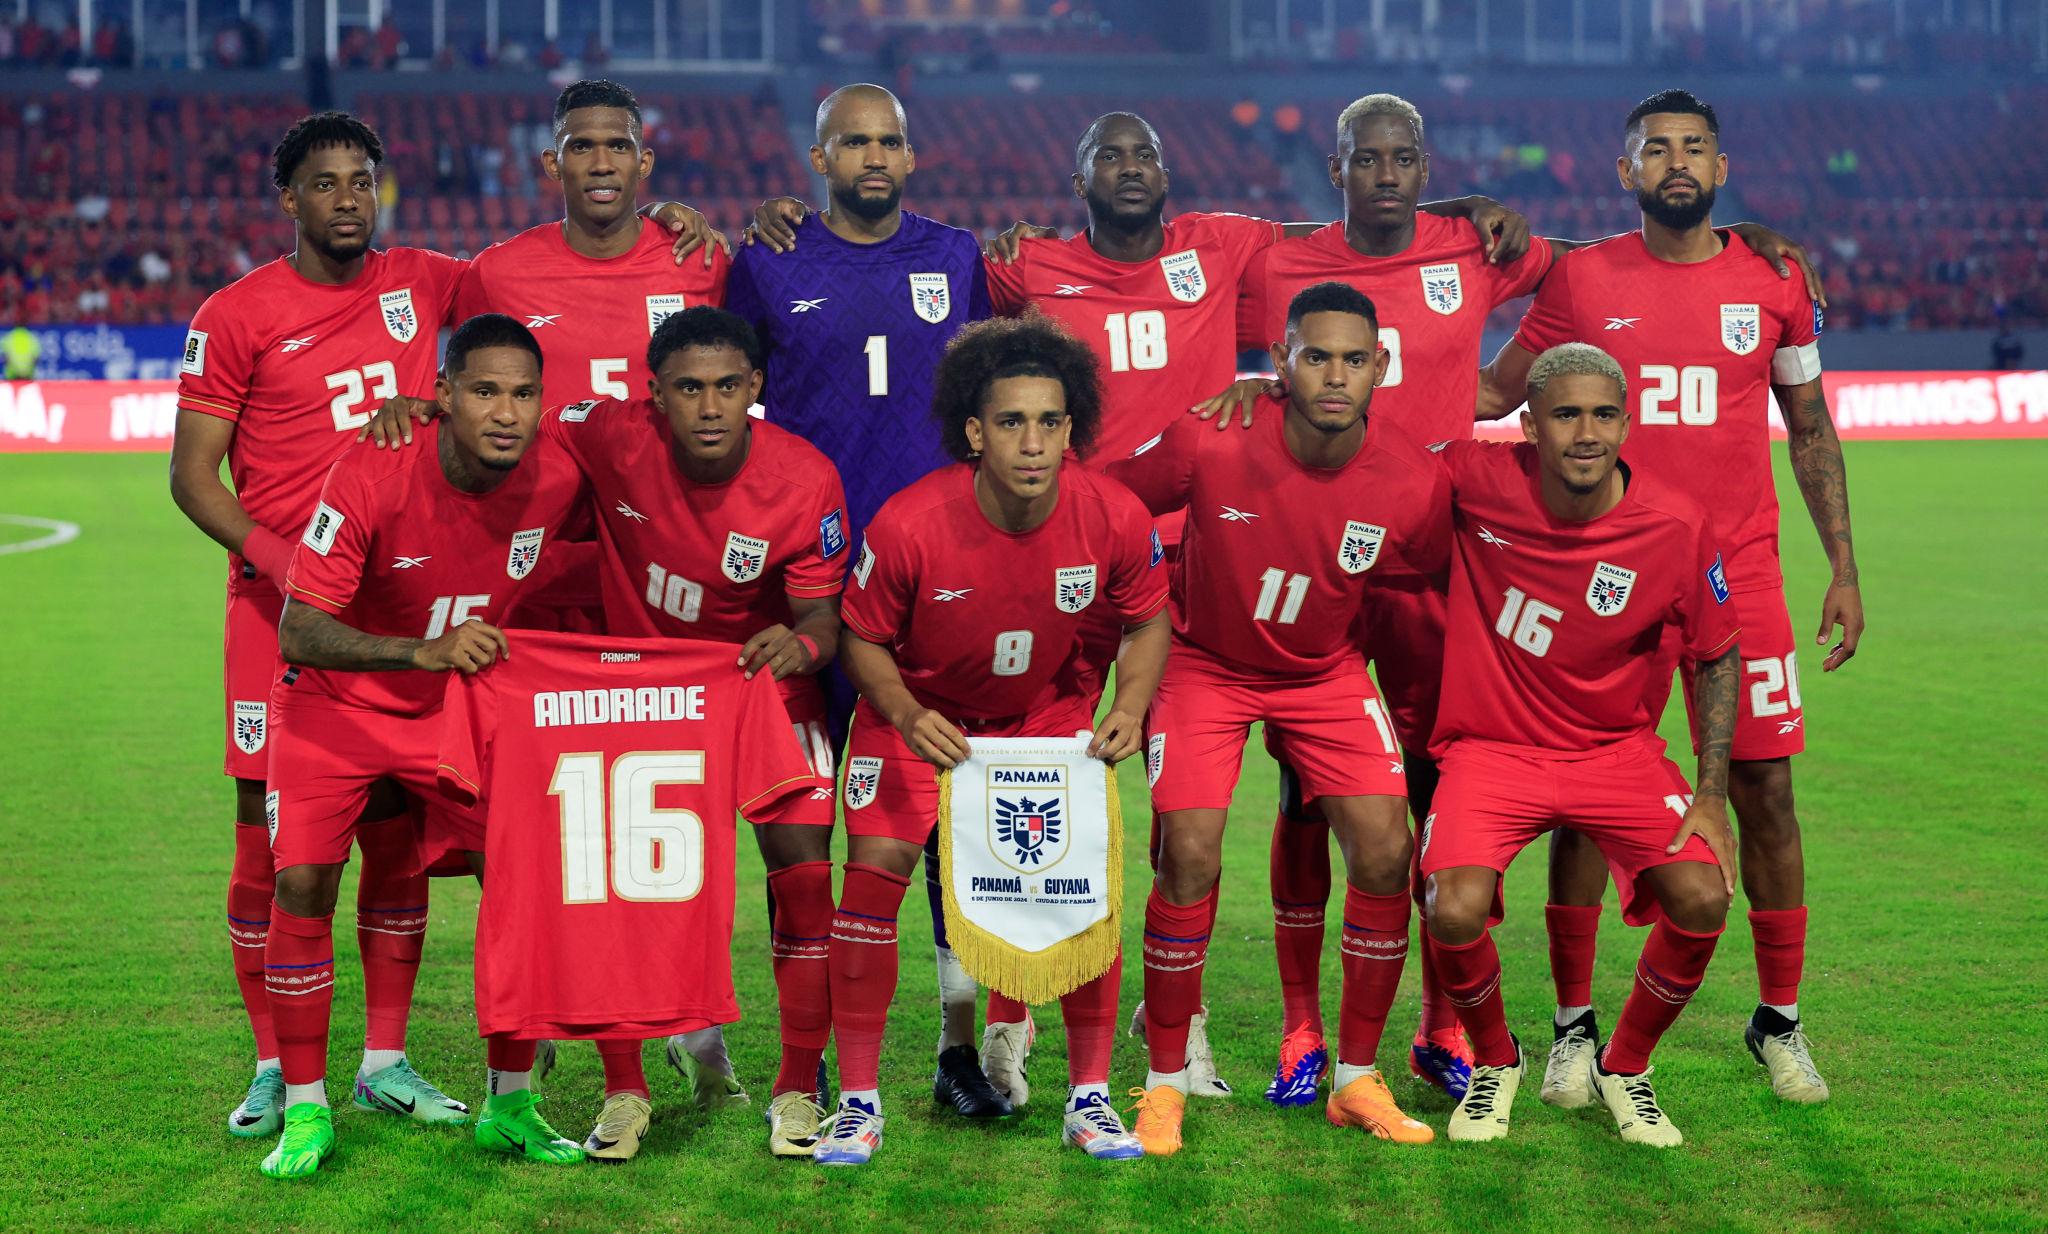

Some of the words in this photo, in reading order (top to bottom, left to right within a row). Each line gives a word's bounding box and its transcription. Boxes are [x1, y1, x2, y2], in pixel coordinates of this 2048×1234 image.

[1104, 310, 1168, 372] 18
[591, 358, 629, 401] 5
[864, 335, 888, 396] 1
[325, 360, 399, 432] 23
[1640, 364, 1719, 426] 20
[731, 535, 765, 549] PANAMÁ
[1349, 524, 1381, 536] PANAMÁ
[646, 561, 704, 623] 10
[1059, 568, 1093, 577] PANAMÁ
[1599, 565, 1632, 580] PANAMÁ
[1253, 566, 1313, 625] 11
[1496, 585, 1564, 658] 16
[993, 629, 1034, 677] 8
[534, 685, 705, 727] ANDRADE
[852, 759, 879, 767] PANAMÁ
[994, 769, 1060, 783] PANAMÁ
[546, 750, 706, 904] 16
[972, 876, 1022, 893] PANAMÁ
[1044, 878, 1091, 895] GUYANA
